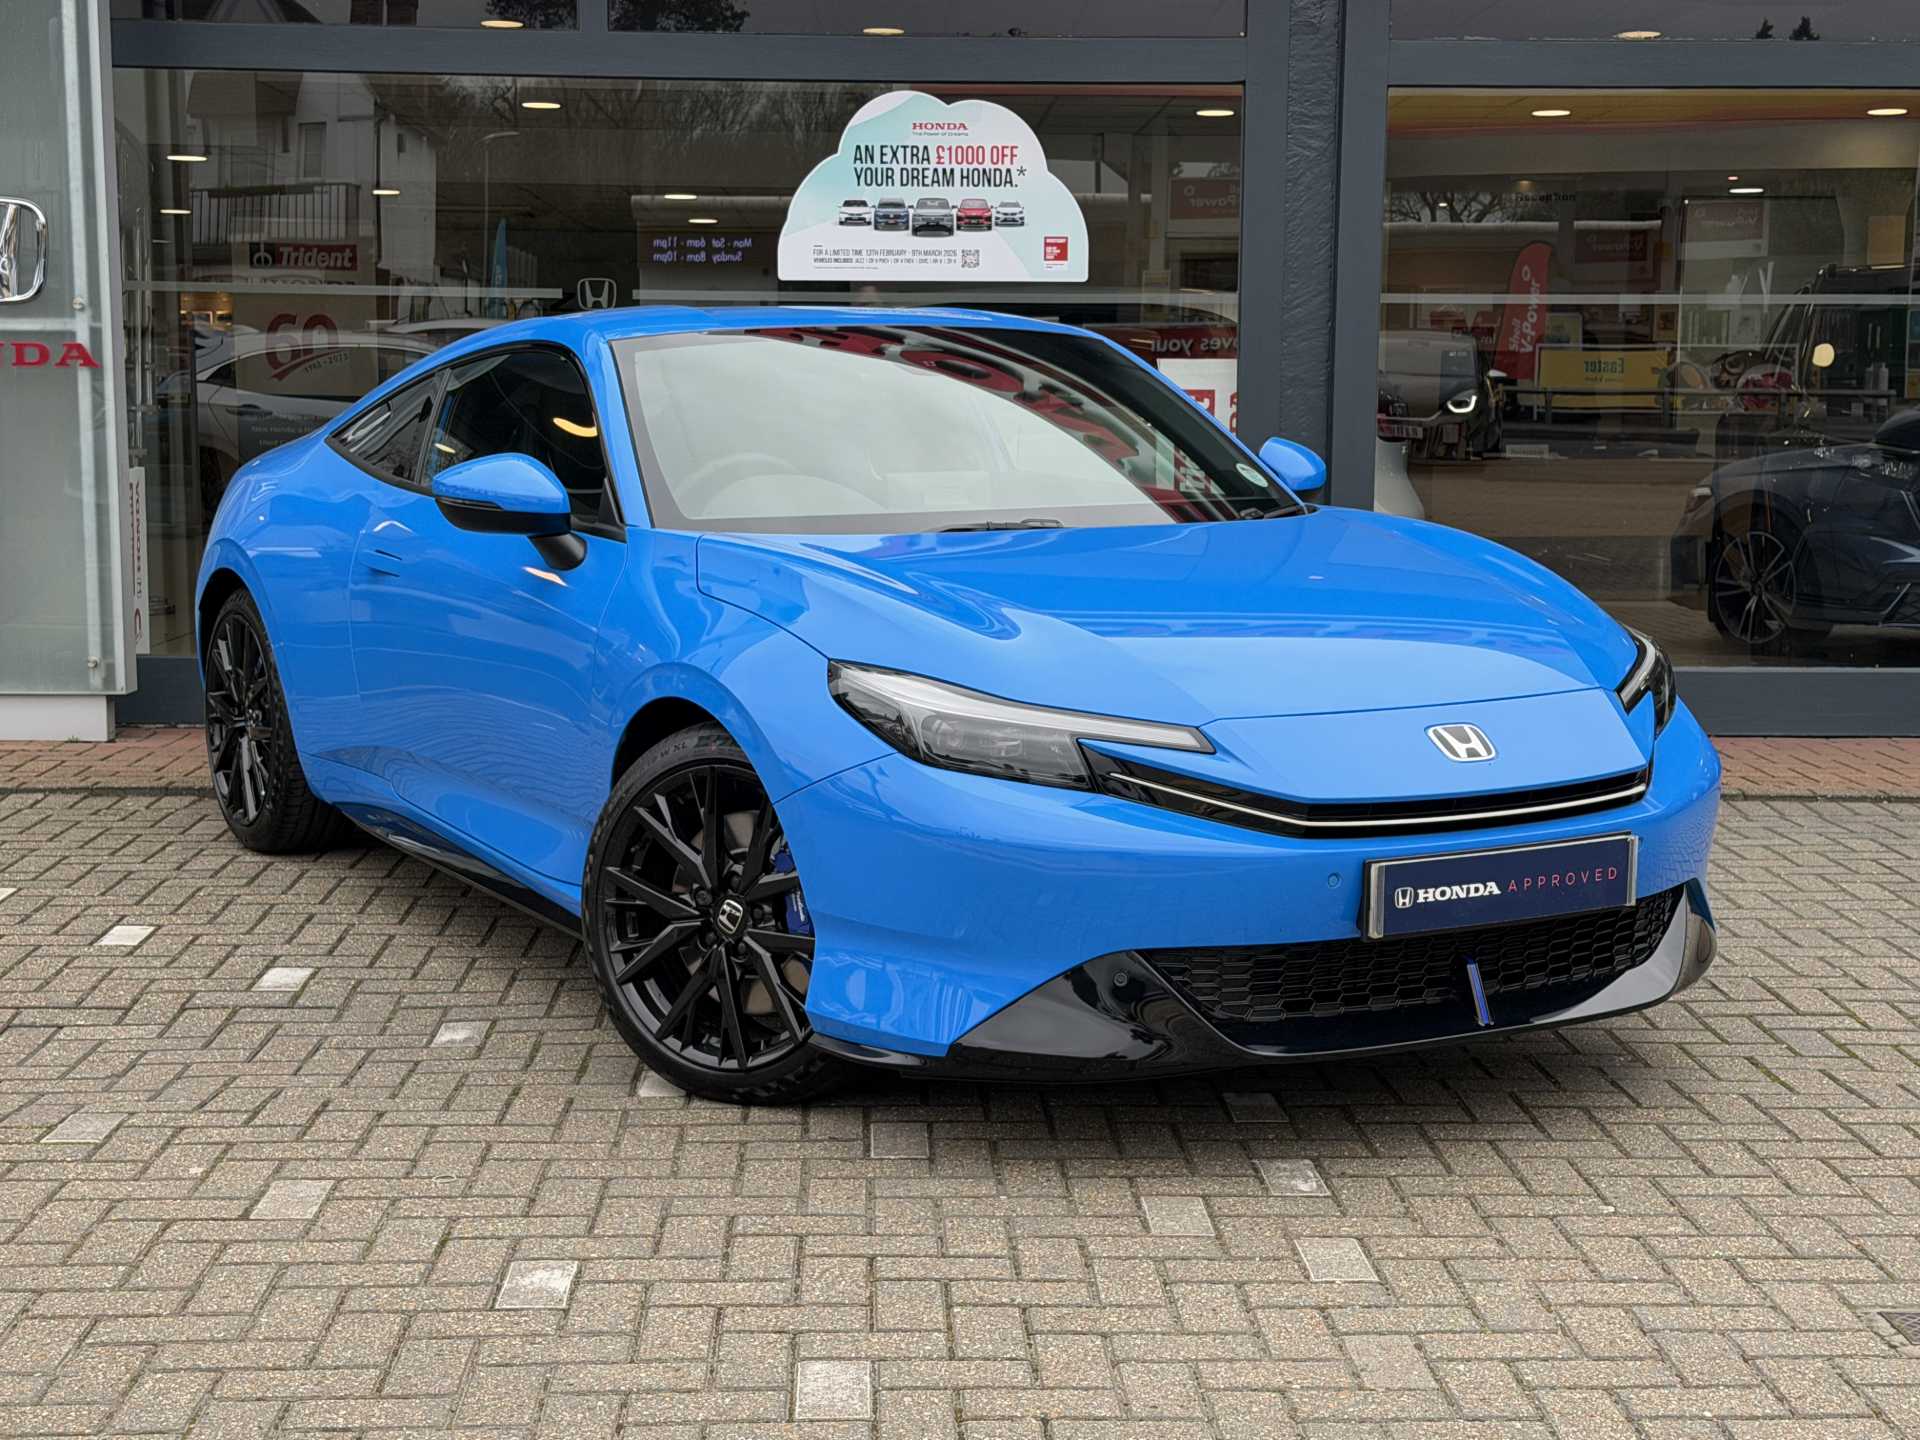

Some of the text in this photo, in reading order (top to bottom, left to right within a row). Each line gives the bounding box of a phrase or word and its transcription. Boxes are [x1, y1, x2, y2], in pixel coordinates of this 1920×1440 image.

[912, 122, 968, 130] HONDA
[853, 144, 1018, 165] AN EXTRA £1000 OFF
[854, 167, 895, 187] YOUR
[900, 167, 955, 187] DREAM
[279, 247, 353, 268] Trident
[0, 341, 102, 368] DA
[1416, 866, 1618, 903] HONDA APPROVED
